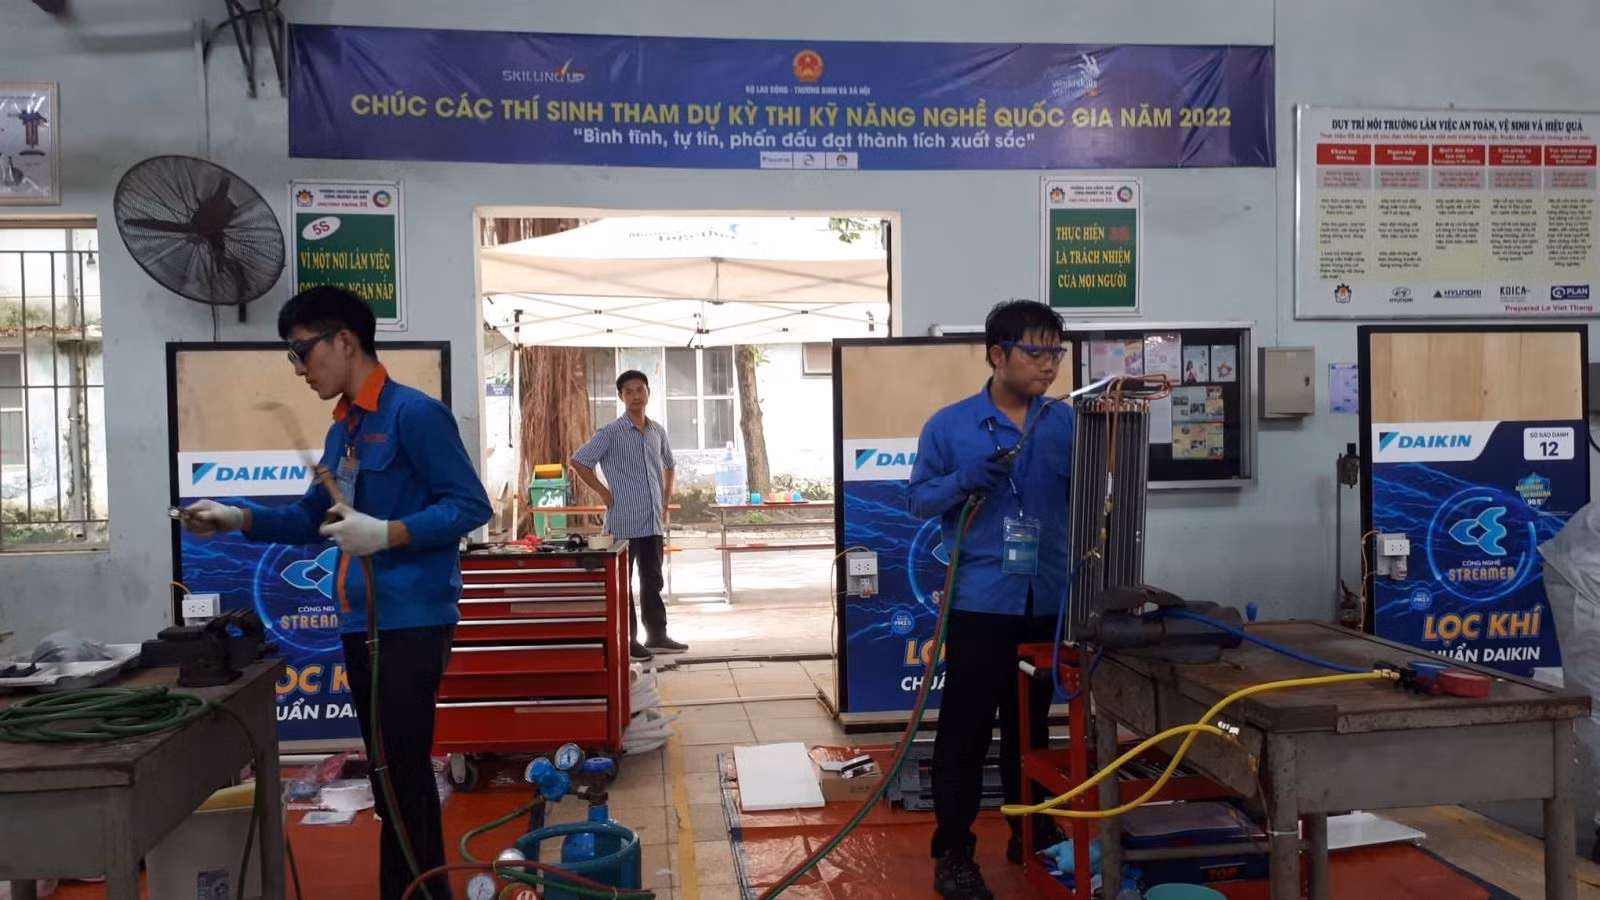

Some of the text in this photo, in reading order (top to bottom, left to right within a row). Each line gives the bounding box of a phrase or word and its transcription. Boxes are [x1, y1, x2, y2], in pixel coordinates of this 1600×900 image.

[502, 70, 585, 83] SKILLING UP
[756, 86, 768, 94] LAO
[838, 85, 848, 94] VÀ
[351, 90, 1232, 130] CHÚC CÁC THÍ SINH THAM DỰ KỲ THI KỸ NĂNG NGHỀ QUỐC GIA NĂM 2022
[1331, 116, 1583, 133] DUY TRÌ MÔI TRƯỜNG LÀM VIỆC AN TOÀN, VỆ SINH VÀ HIỆU QUẢ
[629, 129, 668, 147] tĩnh,
[673, 131, 693, 149] tự
[696, 130, 724, 148] tin,
[730, 128, 775, 149] phấn
[781, 128, 817, 147] đấu
[822, 132, 852, 152] đạt
[857, 133, 908, 148] thành
[912, 132, 945, 148] tích
[951, 131, 990, 148] xuất
[312, 220, 331, 235] 5S
[1055, 225, 1081, 244] THỰC
[1083, 222, 1105, 244] HIỆN
[300, 247, 311, 269] VÌ
[312, 247, 330, 273] MỘT
[350, 248, 368, 270] LÀM
[370, 248, 390, 274] VIỆC
[1056, 246, 1131, 267] LÀ TRÁCH NHIỆM
[1058, 269, 1127, 292] CỦA MỌI NGƯỜI
[1444, 289, 1482, 297] HYUNDAI
[1500, 286, 1527, 296] KOICA
[1566, 287, 1588, 296] PLAN
[1568, 304, 1593, 312] Thang
[1398, 434, 1472, 449] DAIKIN
[1539, 441, 1559, 457] 12
[215, 464, 307, 482] DAIKIN
[1448, 566, 1515, 582] STREAMER
[297, 605, 321, 613] CÔNG
[1423, 603, 1543, 646] LỌC KHÍ
[1483, 646, 1540, 662] DAIKIN
